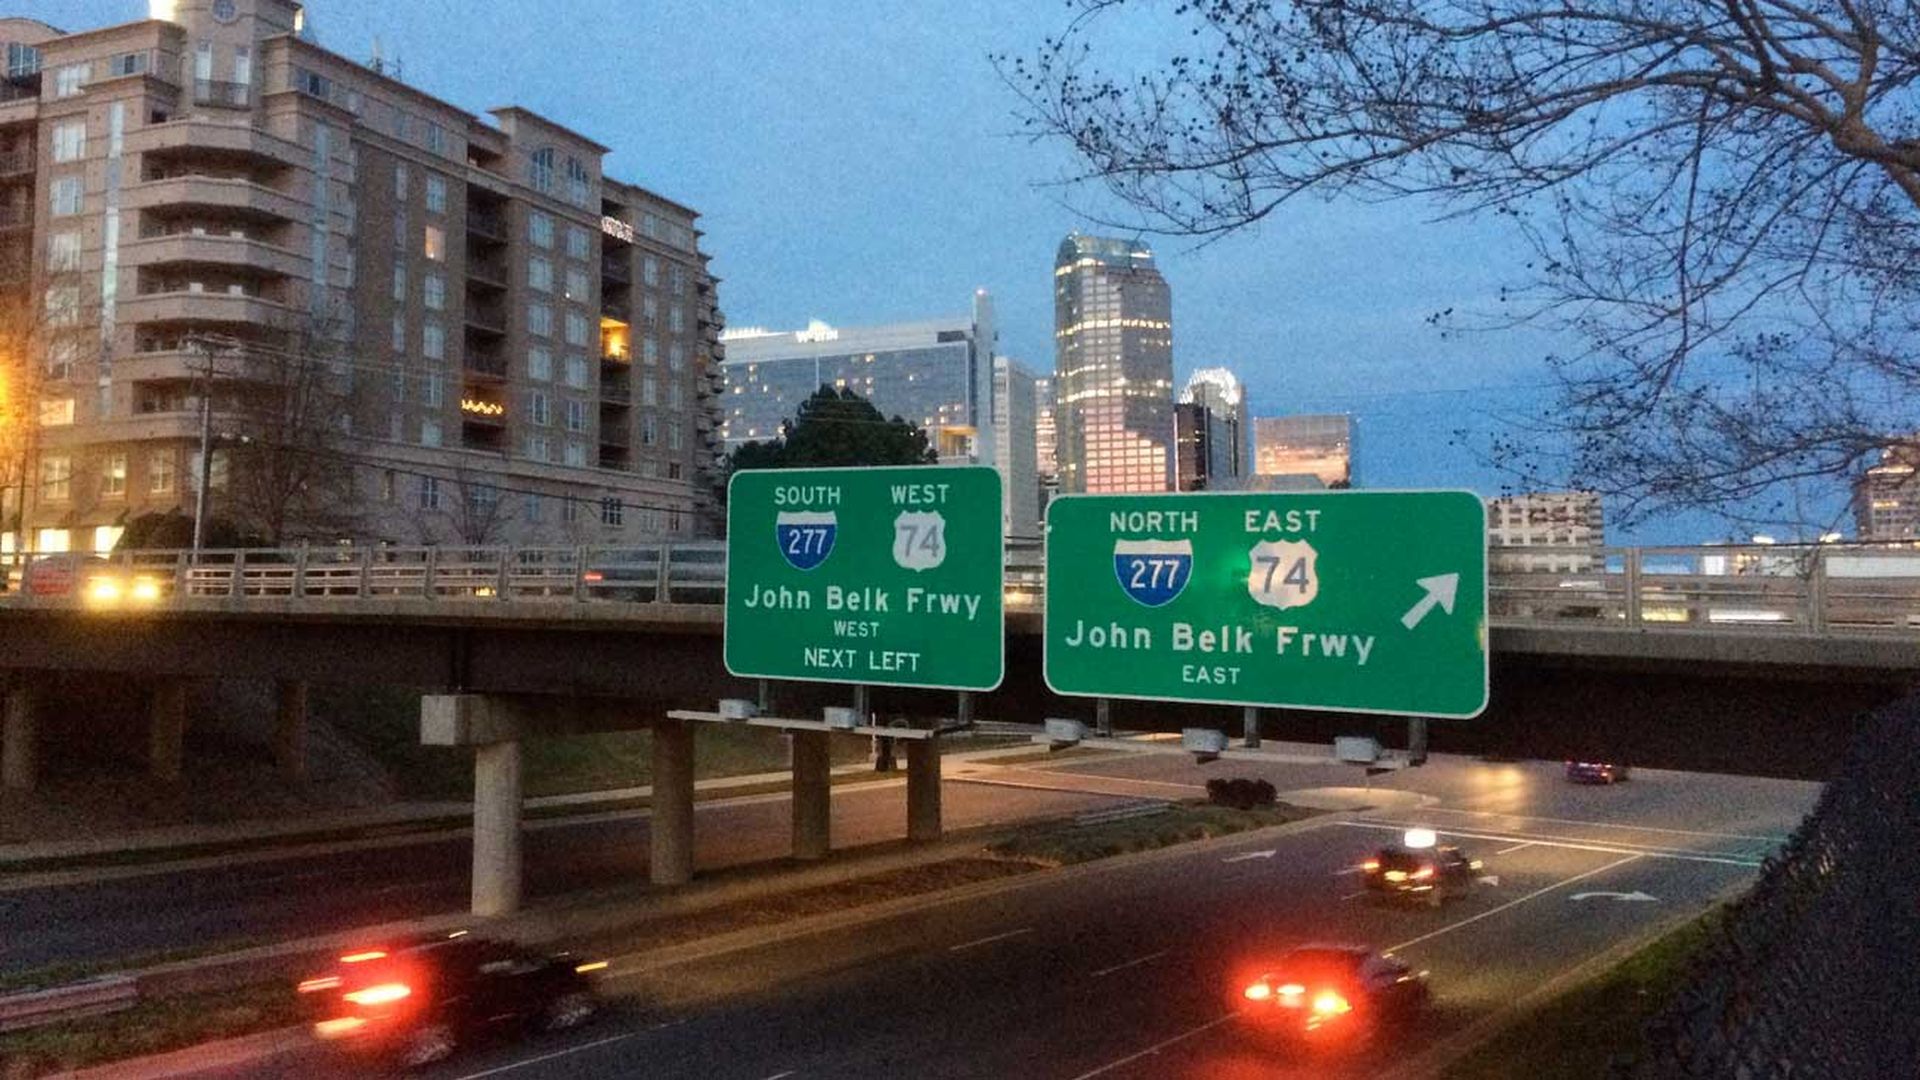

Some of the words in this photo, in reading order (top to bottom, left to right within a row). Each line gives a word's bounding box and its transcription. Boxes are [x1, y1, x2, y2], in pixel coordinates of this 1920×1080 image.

[774, 486, 841, 505] SOUTH
[891, 484, 949, 503] WEST
[1110, 511, 1198, 532] NORTH
[1245, 510, 1321, 532] EAST
[788, 529, 827, 554] 277
[900, 524, 940, 558] 74
[1130, 560, 1180, 589] 277
[1256, 556, 1309, 595] 74
[744, 584, 811, 609] John
[826, 585, 889, 612] Belk
[907, 588, 981, 620] Frwy
[834, 620, 880, 637] WEST
[1065, 620, 1151, 650] John
[1172, 622, 1253, 653] Belk
[1277, 626, 1375, 665] Frwy
[804, 648, 856, 667] NEXT
[869, 651, 920, 672] LEFT
[1182, 664, 1241, 684] EAST
